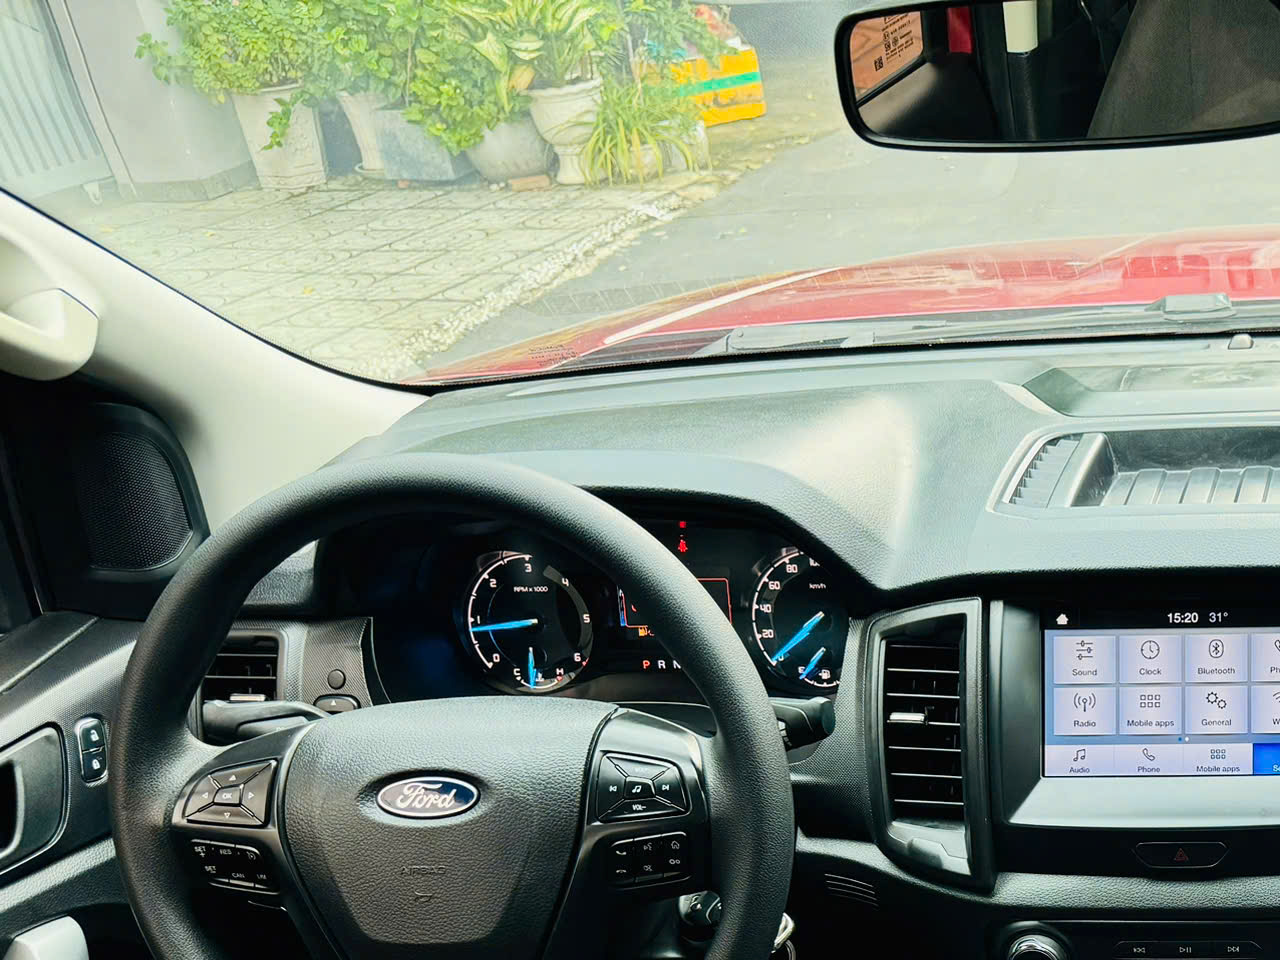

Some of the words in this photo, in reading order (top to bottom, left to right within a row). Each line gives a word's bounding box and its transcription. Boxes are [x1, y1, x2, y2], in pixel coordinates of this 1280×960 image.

[524, 563, 532, 572] 3
[786, 564, 798, 573] 80
[489, 579, 497, 588] 2
[561, 577, 569, 586] 4
[768, 581, 780, 590] 60
[760, 604, 772, 613] 40
[476, 615, 481, 624] 1
[583, 614, 590, 623] 5
[1167, 611, 1199, 623] 15:20
[1208, 611, 1229, 623] 31°
[762, 629, 774, 638] 20
[492, 653, 500, 662] 0
[574, 653, 581, 662] 6
[642, 660, 651, 669] P
[657, 660, 666, 669] R
[513, 668, 521, 676] C
[1139, 667, 1162, 675] Clock
[1197, 667, 1236, 675] Bluetooth
[396, 782, 457, 809] Ford
[401, 866, 446, 875] AIRBAG
